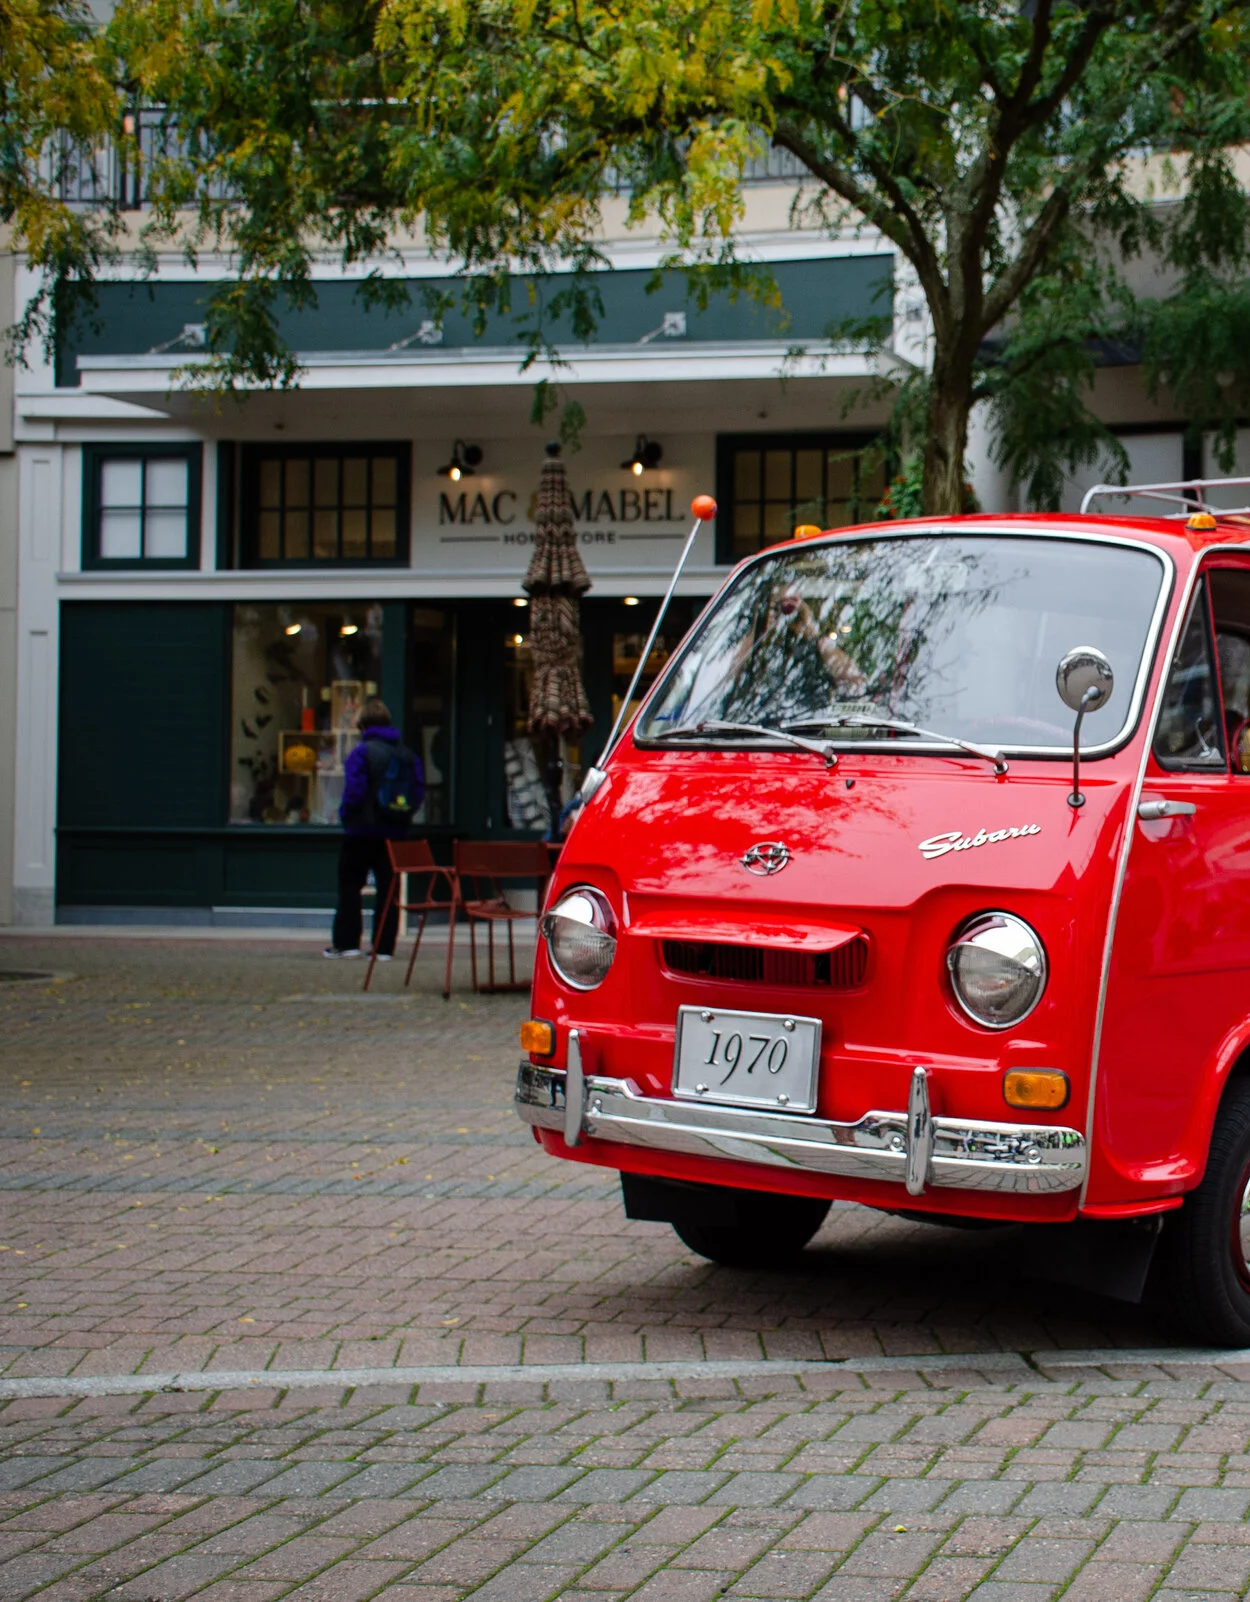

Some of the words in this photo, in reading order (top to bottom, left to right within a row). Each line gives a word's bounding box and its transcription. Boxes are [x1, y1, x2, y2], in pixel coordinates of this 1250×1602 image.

[438, 491, 517, 525] MAC
[566, 487, 685, 522] MABEL
[503, 531, 545, 547] HO
[570, 530, 617, 546] ORE
[918, 823, 1041, 860] Subaru
[704, 1029, 789, 1085] 1970
